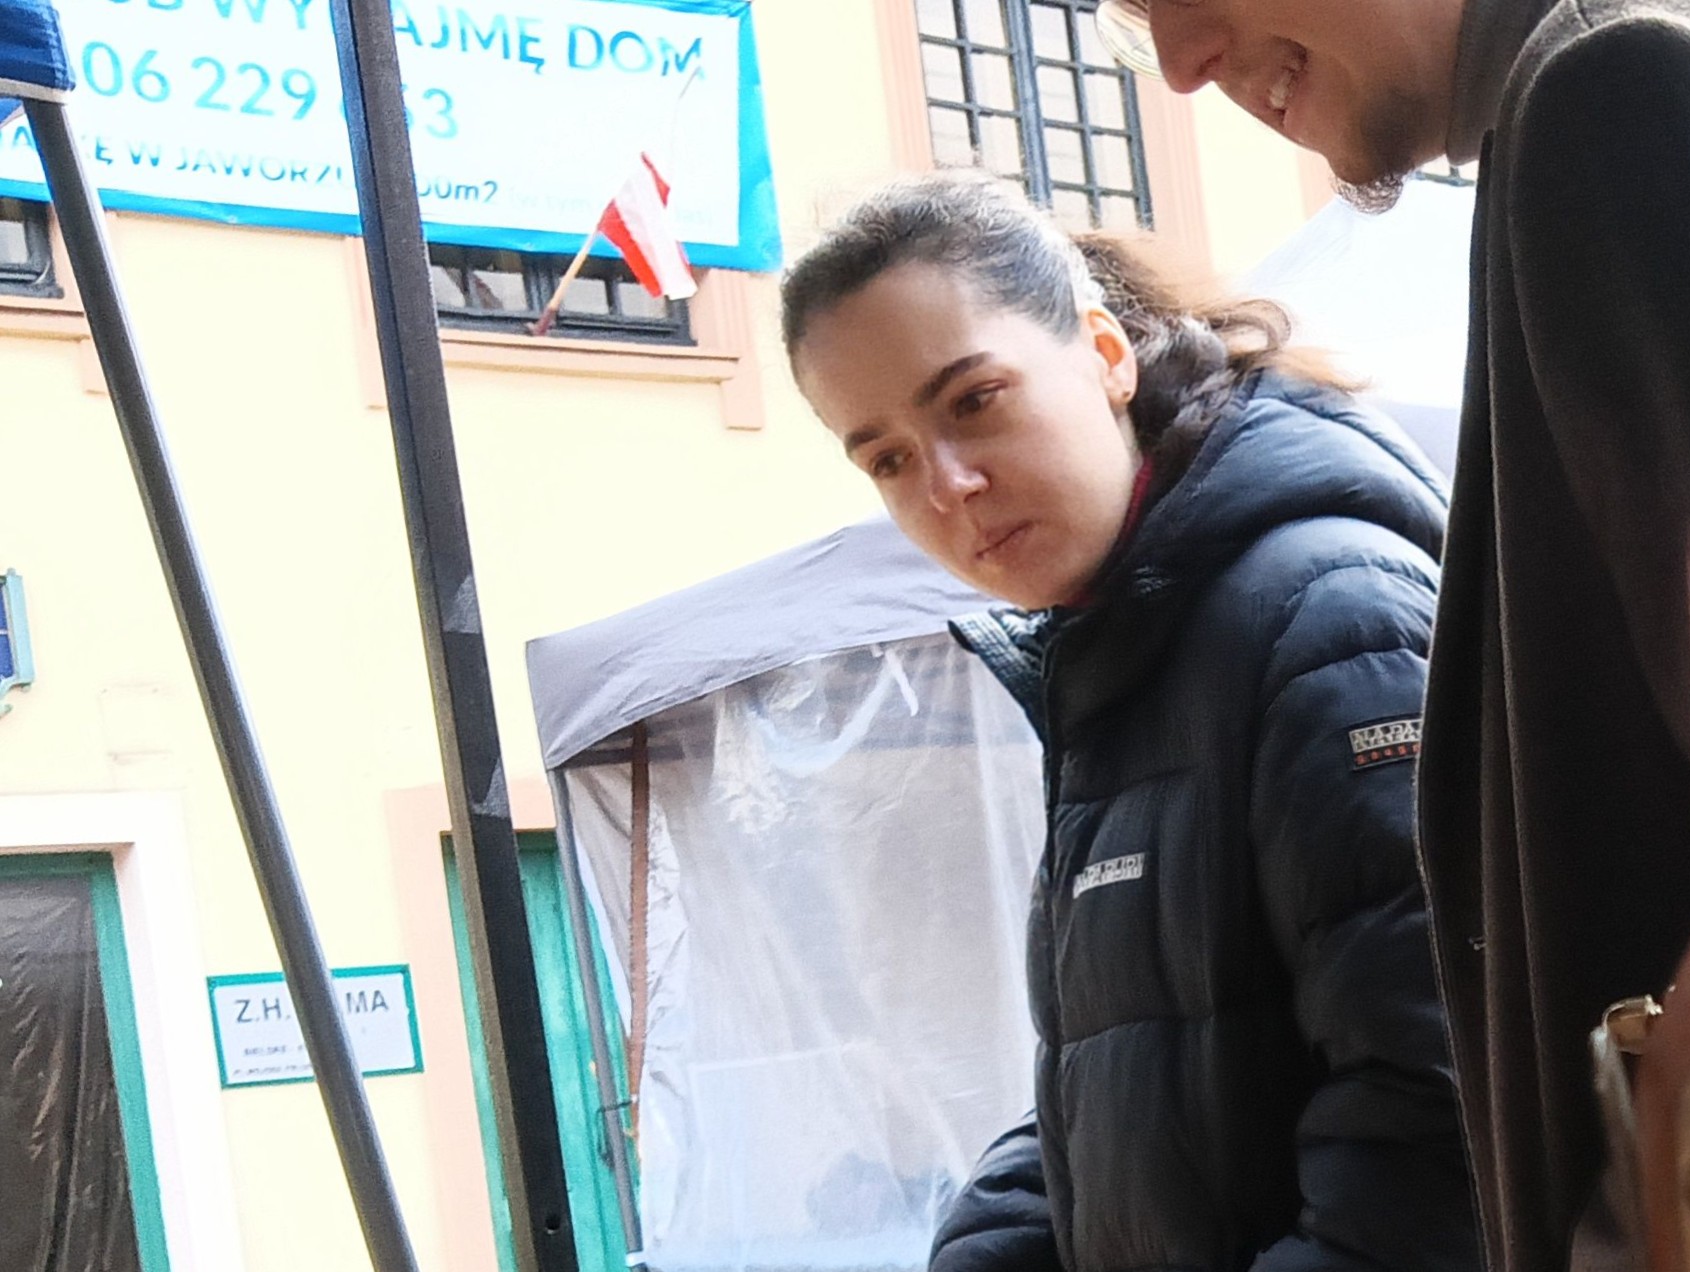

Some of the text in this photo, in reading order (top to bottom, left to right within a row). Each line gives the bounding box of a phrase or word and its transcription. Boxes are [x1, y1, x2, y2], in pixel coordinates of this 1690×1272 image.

[566, 22, 705, 79] DOM
[81, 40, 172, 103] 06
[190, 55, 319, 122] 229
[346, 989, 389, 1014] MA
